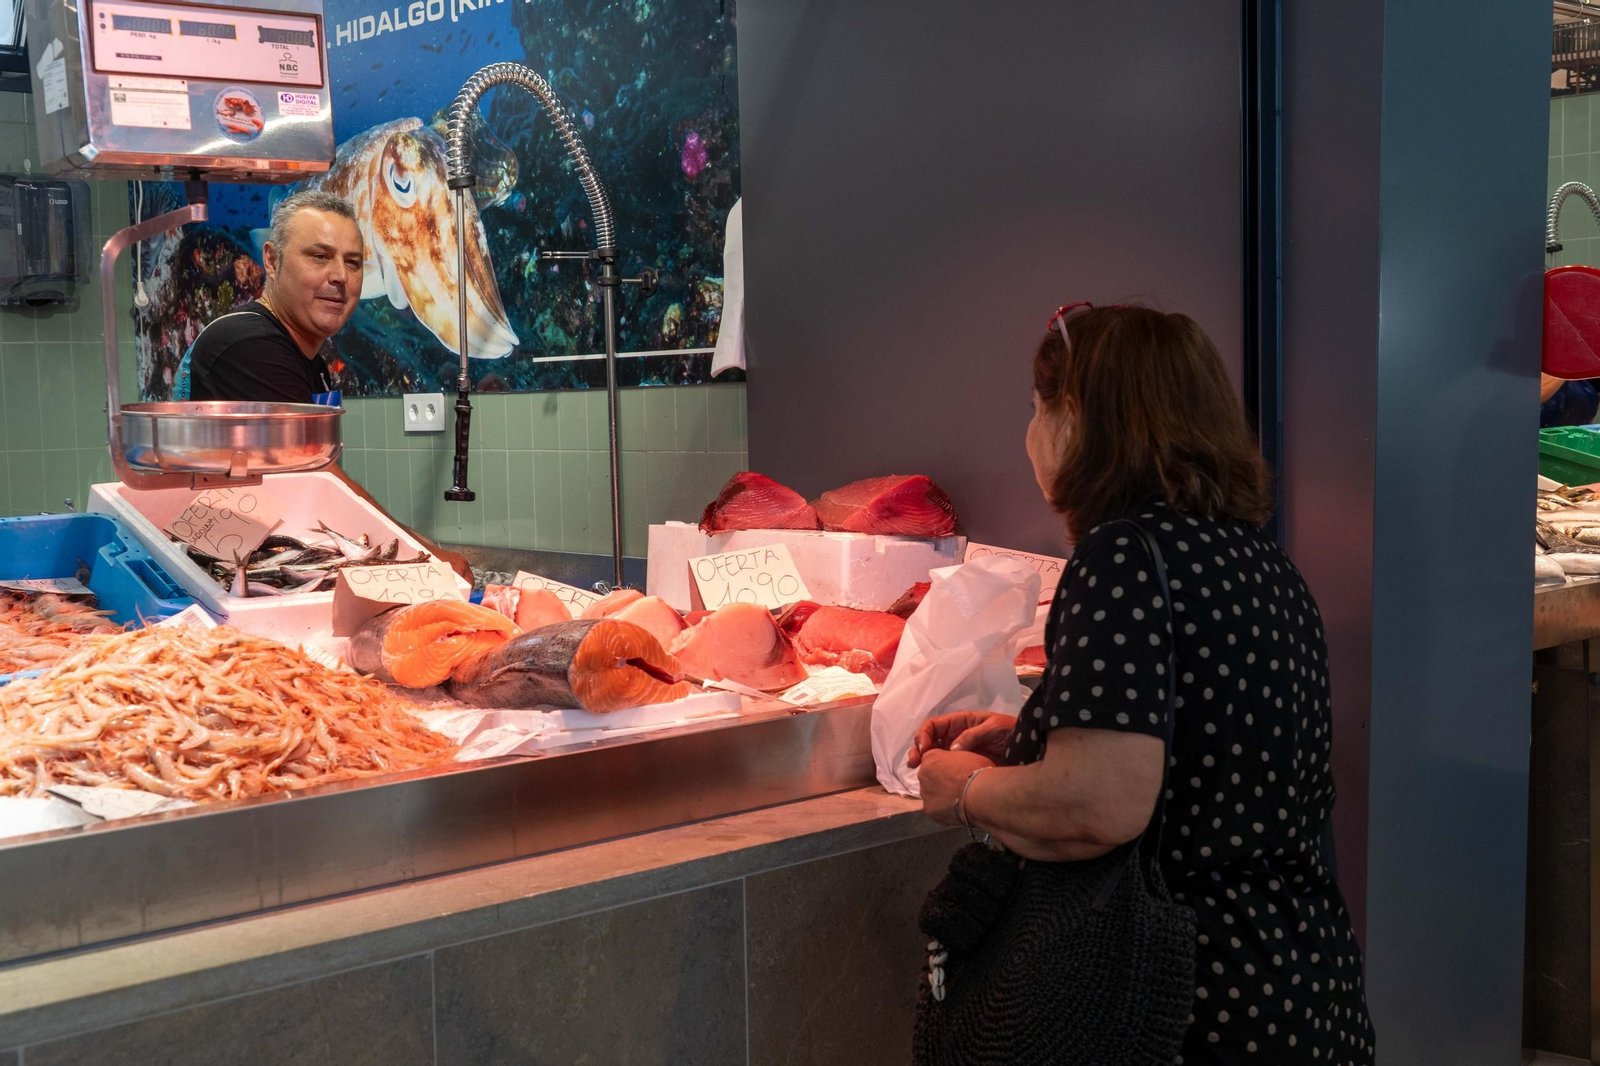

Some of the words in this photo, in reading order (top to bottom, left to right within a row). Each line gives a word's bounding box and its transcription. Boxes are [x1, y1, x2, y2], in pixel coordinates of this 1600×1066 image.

[336, 0, 445, 46] HIDALGO
[172, 487, 235, 538] OFERT
[349, 565, 442, 586] OFERTA
[696, 549, 780, 582] OFERTA
